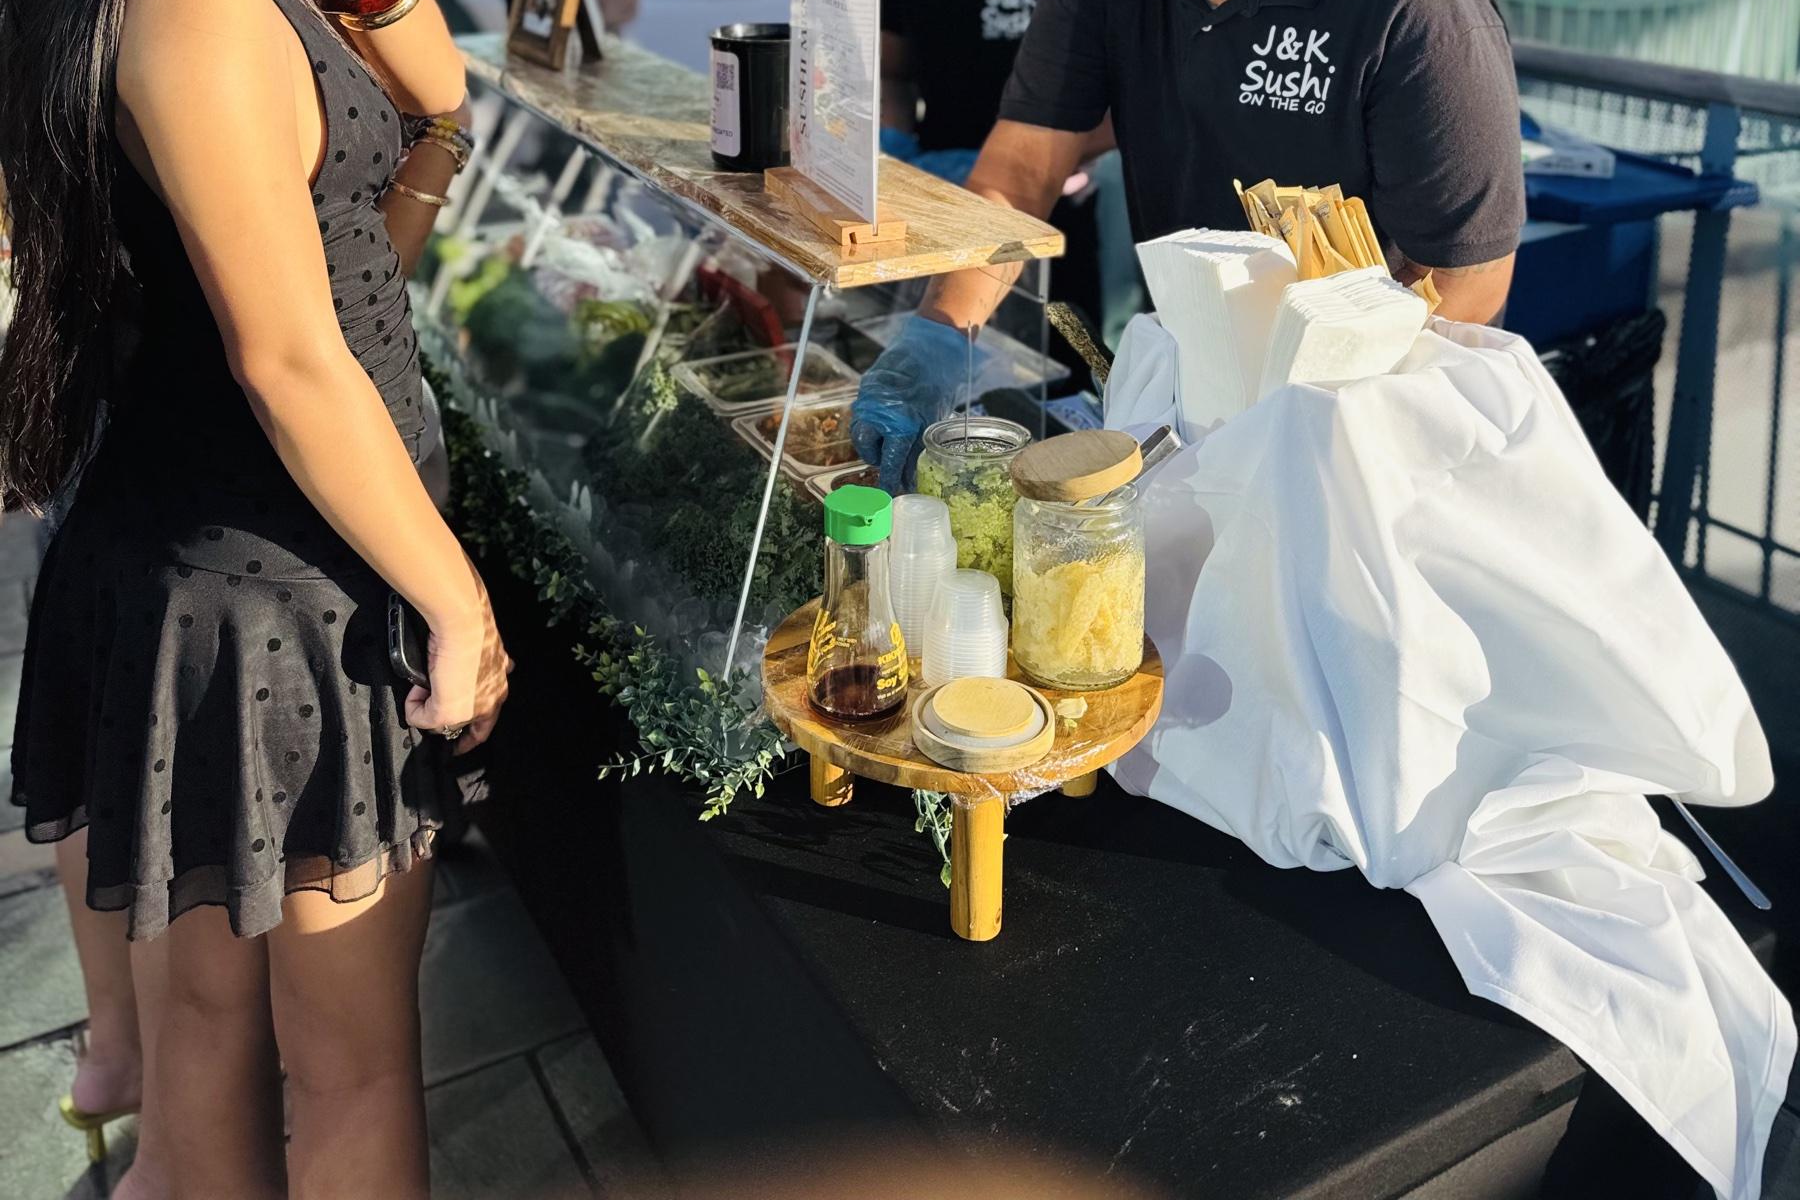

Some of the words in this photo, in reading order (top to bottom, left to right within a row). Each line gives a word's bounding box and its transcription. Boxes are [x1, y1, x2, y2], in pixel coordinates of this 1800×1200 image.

[1252, 25, 1330, 63] J&K
[1240, 60, 1335, 101] Sushi
[1239, 91, 1264, 106] ON
[1269, 96, 1300, 111] THE
[1304, 100, 1325, 114] GO
[877, 675, 898, 689] Soy
